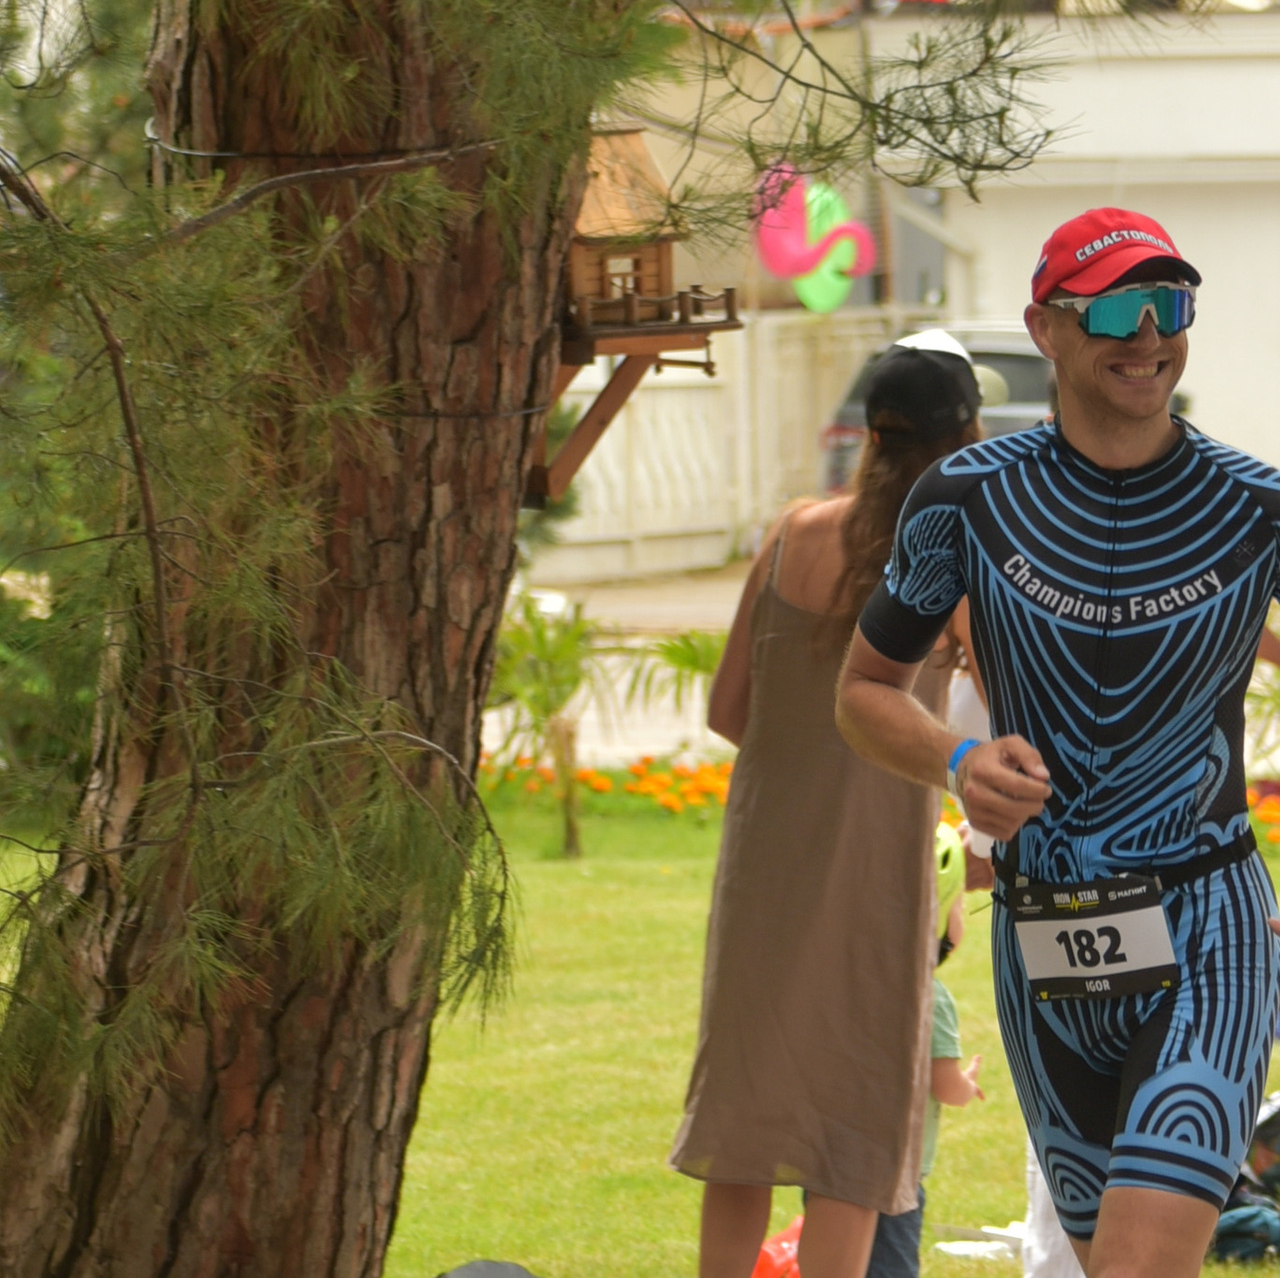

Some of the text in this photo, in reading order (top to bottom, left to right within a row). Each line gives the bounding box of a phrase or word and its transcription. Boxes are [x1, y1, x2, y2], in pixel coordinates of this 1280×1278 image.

[1074, 230, 1174, 262] СЕВАСТОПОЛЬ
[1003, 554, 1223, 624] Champions Factory
[1053, 889, 1099, 904] IRON STAR
[1117, 885, 1148, 899] МАГНИТ
[1055, 926, 1128, 969] 182
[1085, 979, 1111, 994] IGOR
